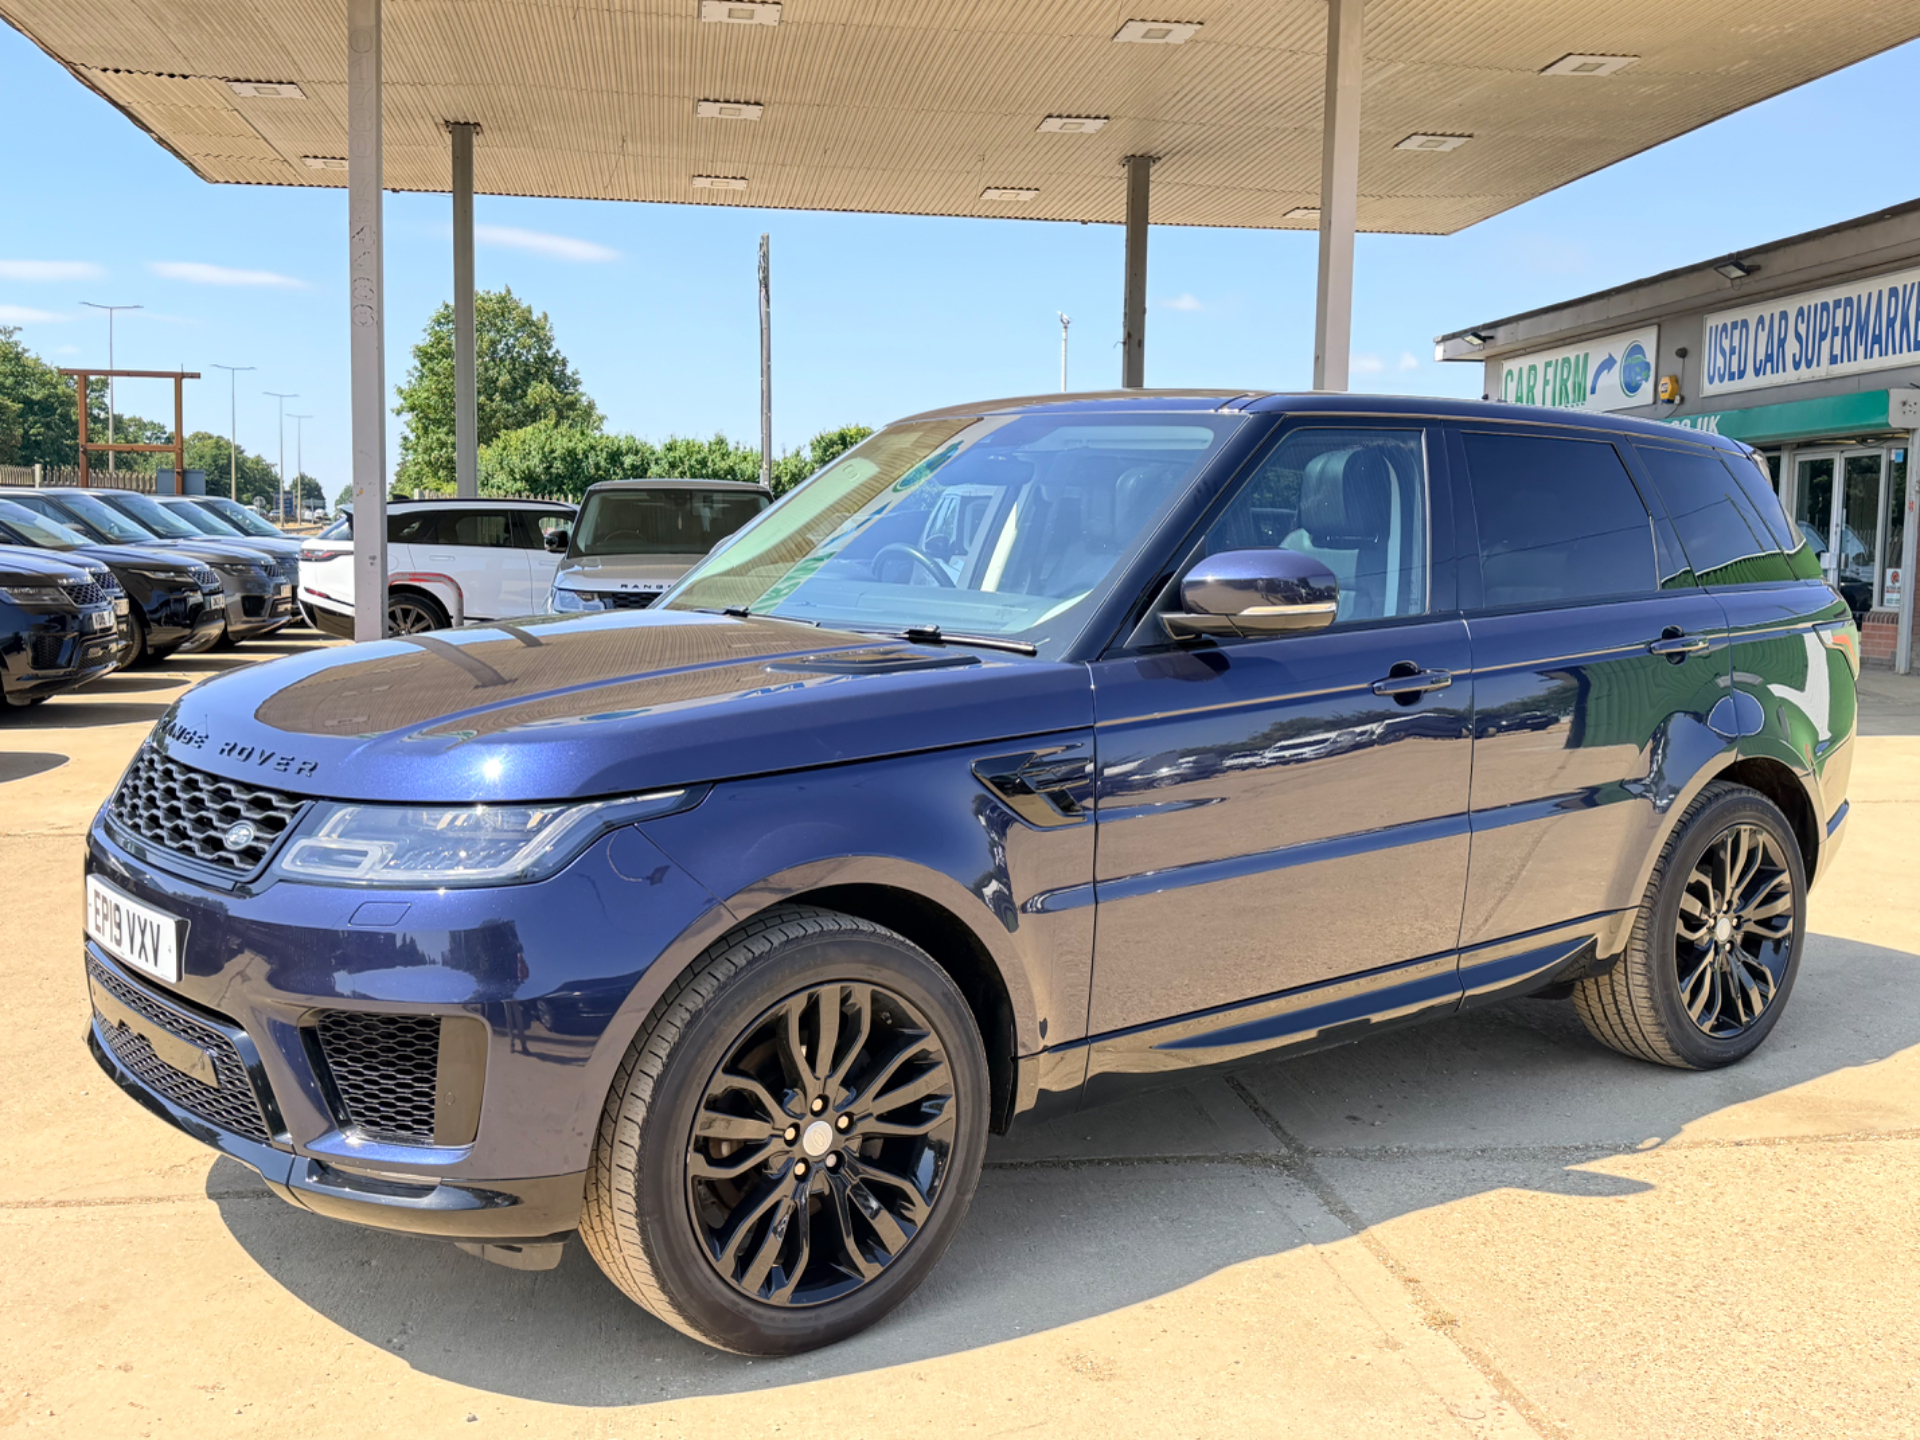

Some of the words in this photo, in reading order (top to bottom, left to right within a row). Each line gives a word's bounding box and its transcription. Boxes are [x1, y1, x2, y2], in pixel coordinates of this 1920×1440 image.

[1505, 364, 1538, 404] CAR
[1542, 352, 1589, 407] FIRM
[1707, 318, 1750, 385] USED
[1753, 310, 1789, 378] CAR
[159, 718, 209, 749] RANGE
[219, 741, 319, 778] ROVER
[94, 888, 122, 948] EP19
[126, 908, 161, 968] VXV
